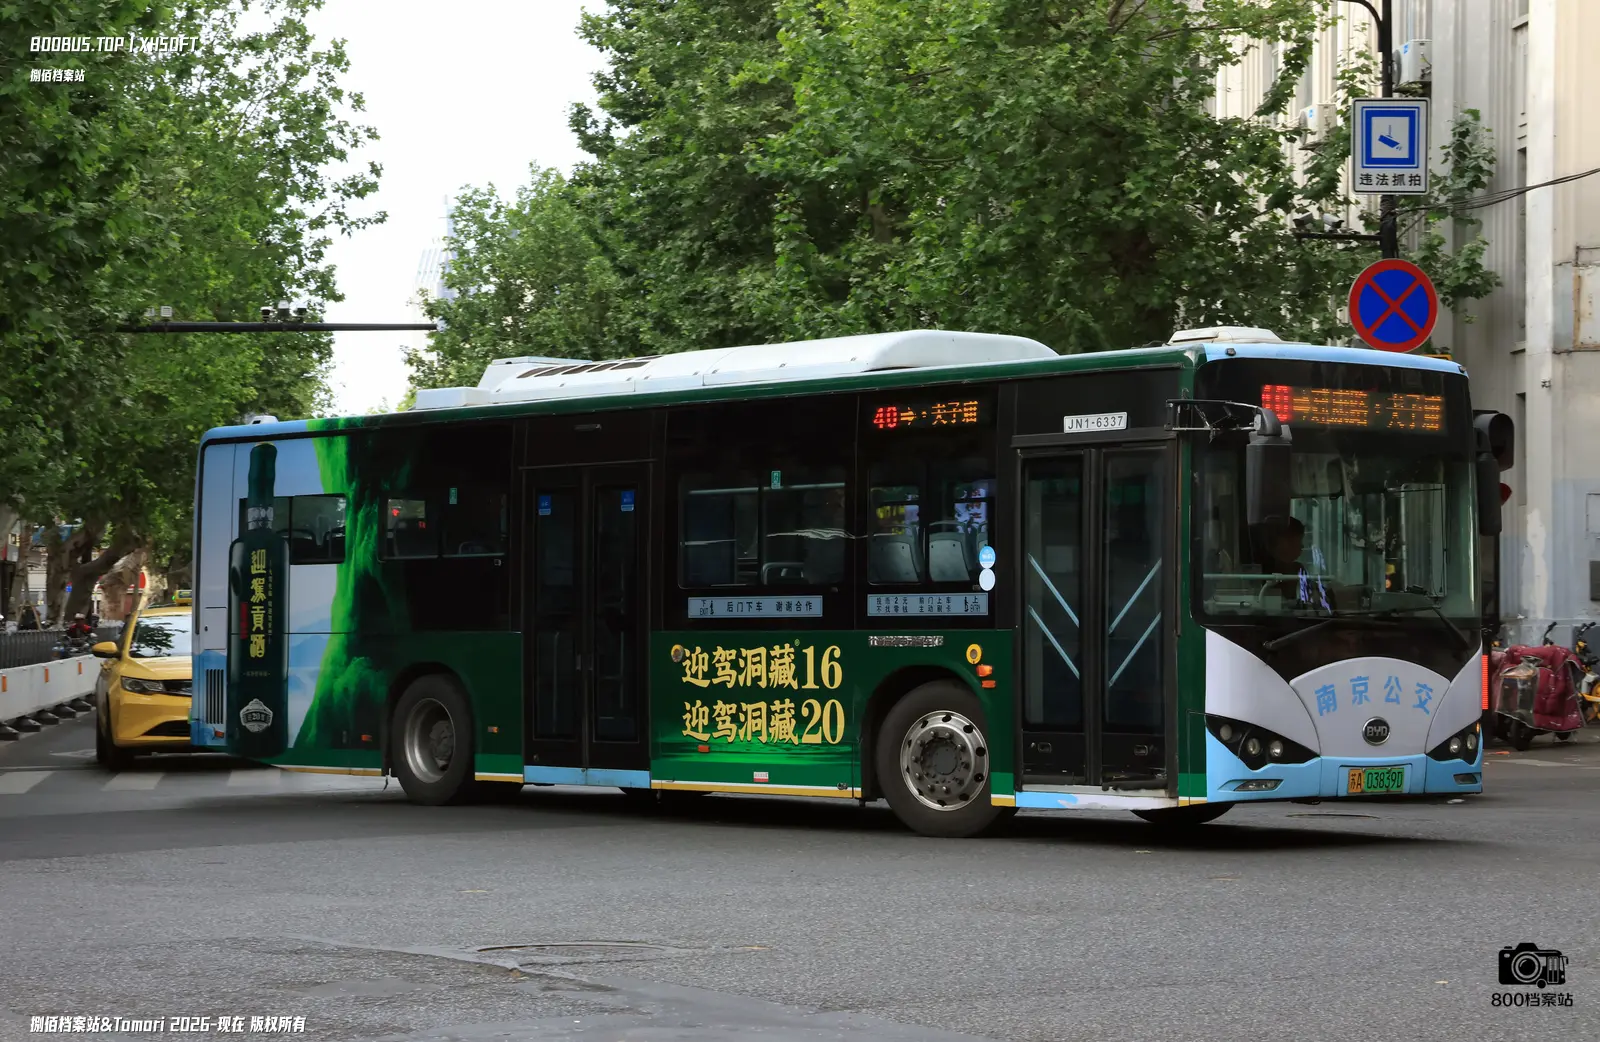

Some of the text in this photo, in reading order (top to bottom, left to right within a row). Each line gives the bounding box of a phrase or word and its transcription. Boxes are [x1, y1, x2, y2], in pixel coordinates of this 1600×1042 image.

[1359, 173, 1422, 187] 违法抓拍
[873, 406, 898, 428] 40
[1067, 415, 1124, 430] JN1-6337
[727, 600, 813, 612] 后门下车 谢谢合作
[1315, 675, 1434, 717] 南京公交
[1366, 726, 1388, 737] BYD
